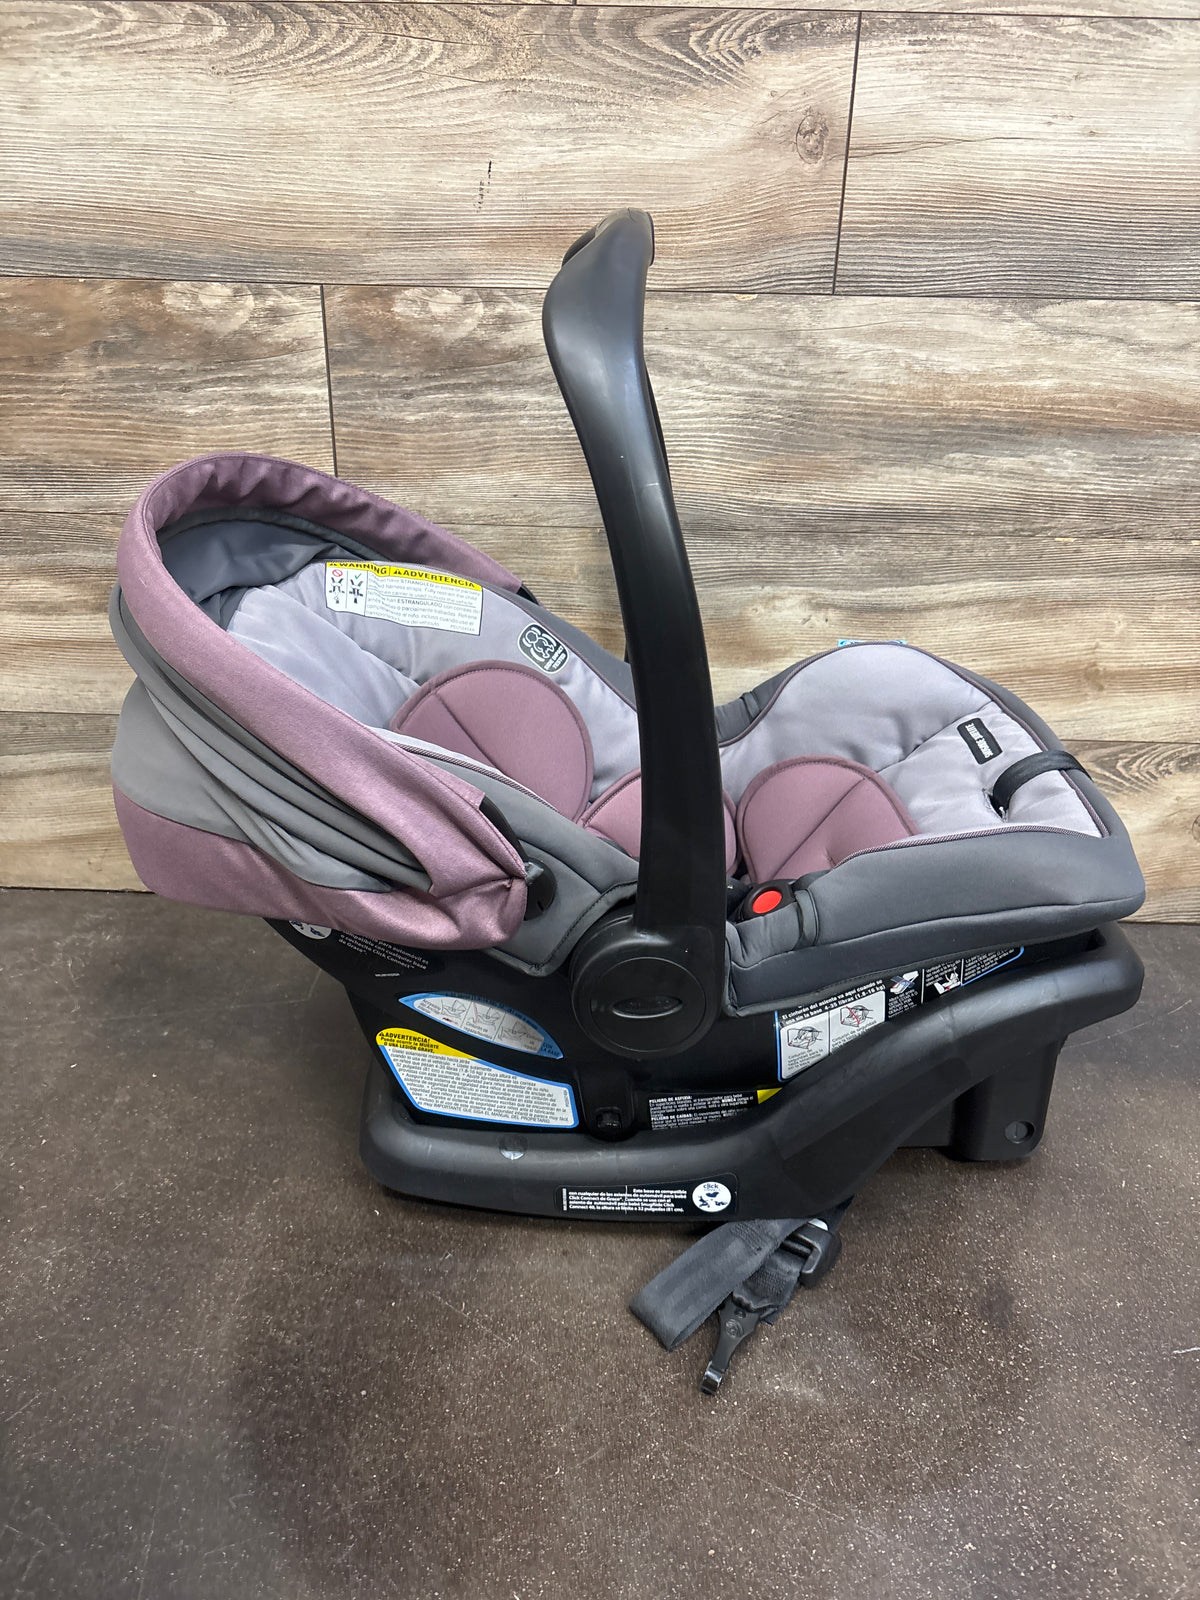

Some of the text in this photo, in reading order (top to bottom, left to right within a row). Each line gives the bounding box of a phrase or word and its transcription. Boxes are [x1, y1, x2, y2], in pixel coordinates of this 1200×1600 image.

[340, 563, 387, 575] WARNING
[403, 570, 475, 588] ADVERTENCIA
[552, 652, 566, 670] TESTED
